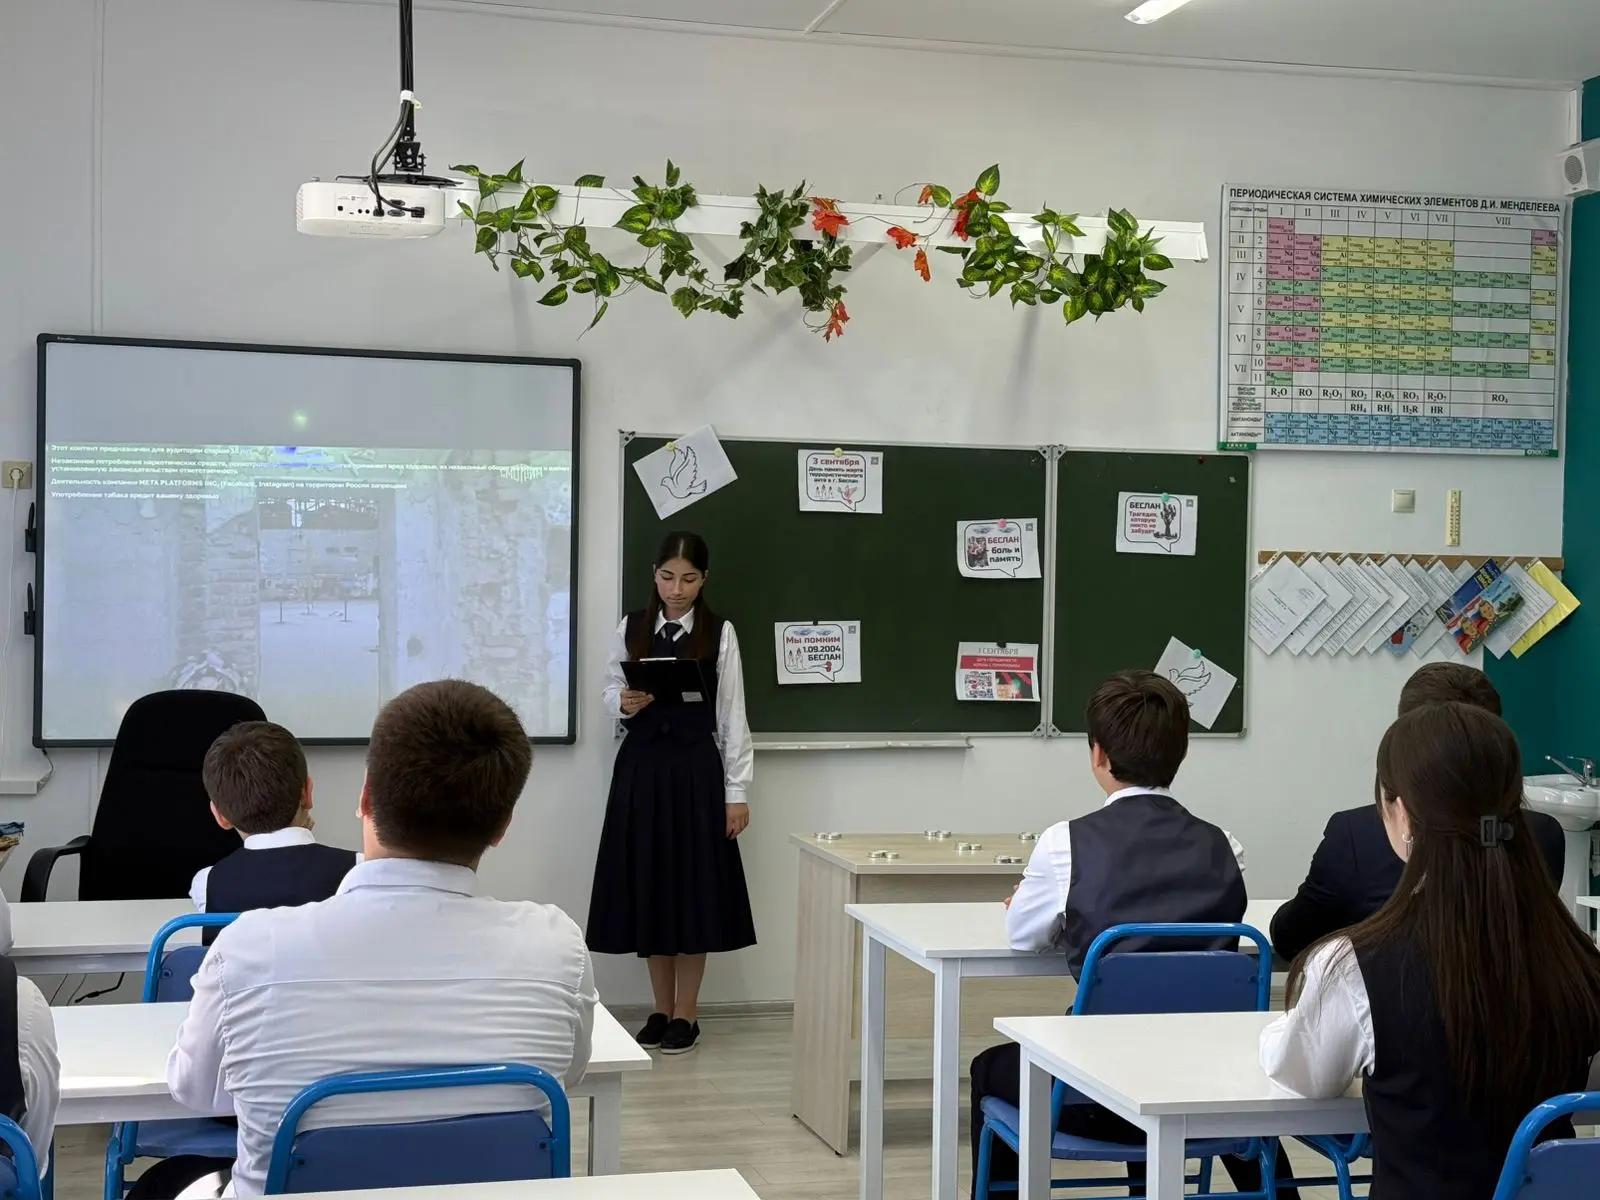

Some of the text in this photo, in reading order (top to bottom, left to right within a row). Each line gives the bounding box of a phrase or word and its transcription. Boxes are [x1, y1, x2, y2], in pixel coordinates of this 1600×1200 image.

[1230, 188, 1560, 213] ПЕРИОДИЧЕСКАЯ СИСТЕМА ХИМИЧЕСКИХ ЭЛЕМЕНТОВ Д.И. МЕНДЕЛЕЕВА
[1304, 208, 1311, 217] II
[1330, 209, 1340, 218] III
[1357, 210, 1367, 218] IV
[1384, 211, 1392, 220] V
[1410, 213, 1419, 221] VI
[1435, 214, 1448, 223] VII
[1495, 216, 1511, 226] VIII
[1238, 235, 1245, 244] II
[1257, 236, 1263, 245] 2
[1236, 250, 1246, 259] III
[1257, 251, 1263, 259] 3
[1236, 272, 1246, 281] IV
[1257, 266, 1263, 274] 4
[1237, 304, 1245, 313] V
[1257, 297, 1263, 306] 6
[1256, 312, 1262, 320] 7
[1235, 334, 1246, 343] VI
[1256, 328, 1261, 337] 8
[1256, 343, 1261, 352] 9
[1234, 364, 1247, 373] VII
[1254, 359, 1264, 367] 10
[1254, 373, 1262, 382] 11
[1298, 388, 1313, 397] RO
[1430, 406, 1444, 414] HR
[812, 457, 860, 467] 3 сентября
[50, 478, 102, 486] Деятельность
[50, 491, 103, 499] Употребление
[1129, 501, 1161, 509] БЕСЛАН
[987, 536, 1020, 544] БЕСЛАН
[991, 546, 1013, 554] боль
[989, 555, 1021, 563] память
[785, 636, 841, 644] Мы помним
[802, 644, 841, 653] 1.09.2004
[807, 653, 841, 662] БЕСЛАН
